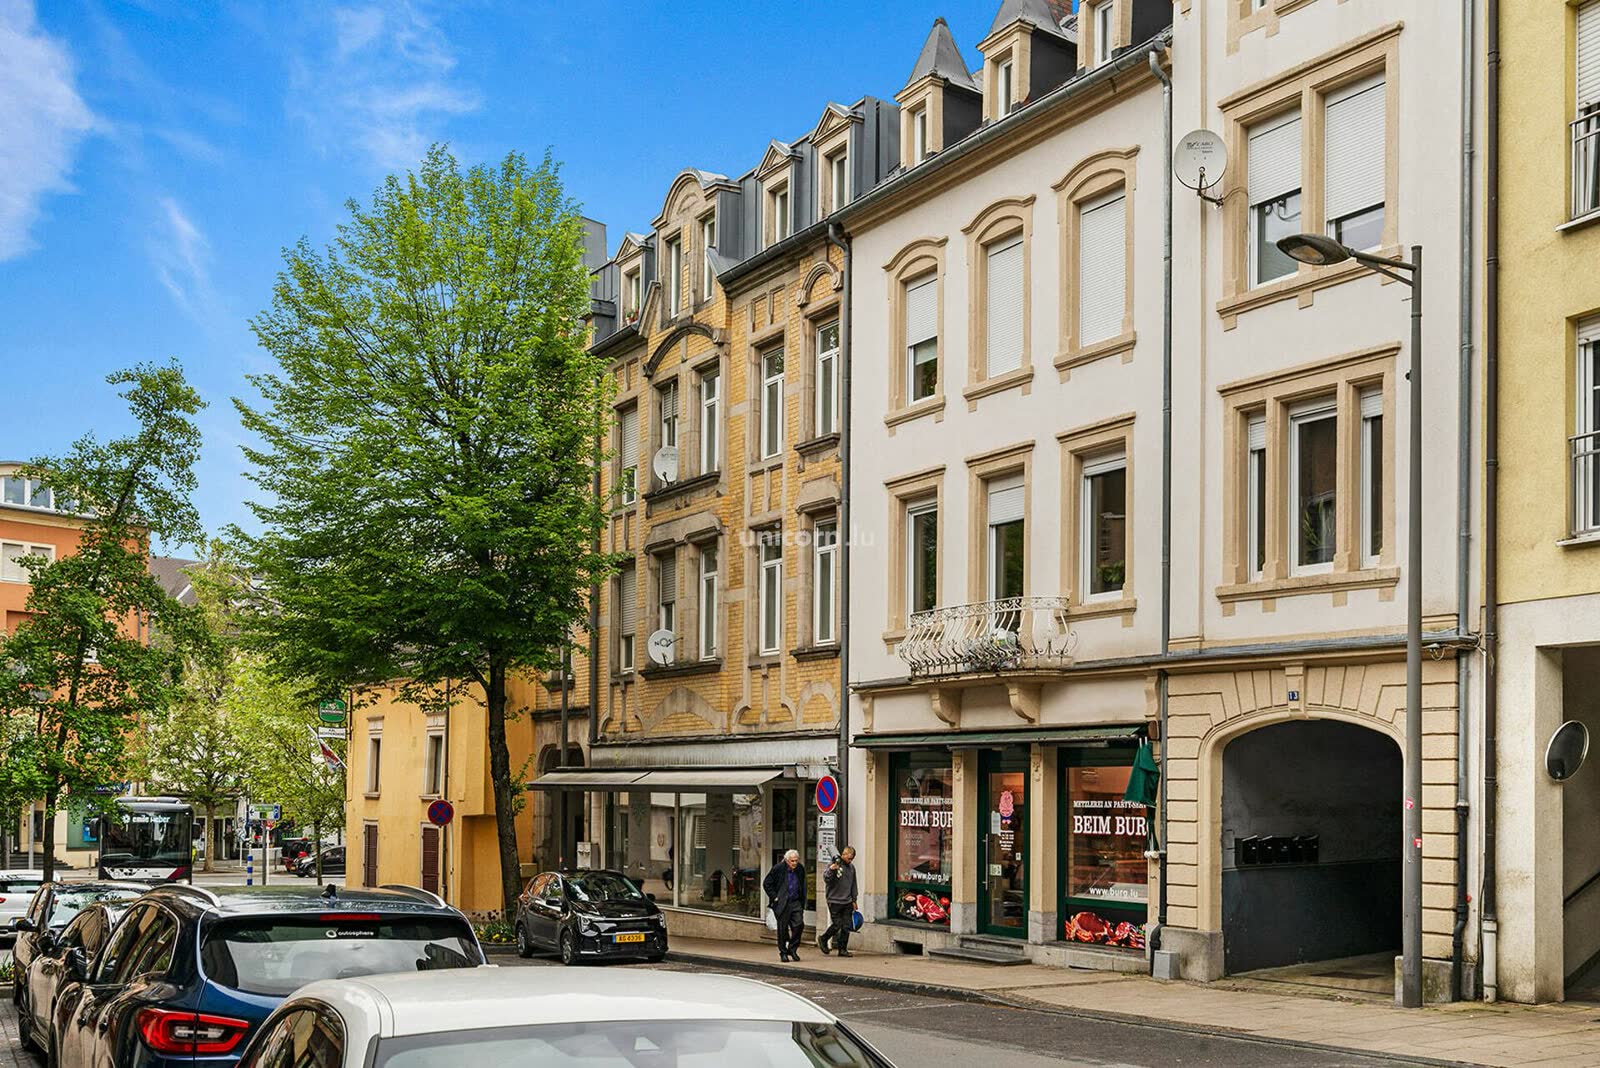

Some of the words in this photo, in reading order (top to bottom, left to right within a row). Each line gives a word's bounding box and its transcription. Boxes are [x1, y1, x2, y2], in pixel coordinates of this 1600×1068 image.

[901, 810, 929, 827] BEIM
[1073, 815, 1112, 835] BEIM
[1115, 816, 1149, 836] BUR
